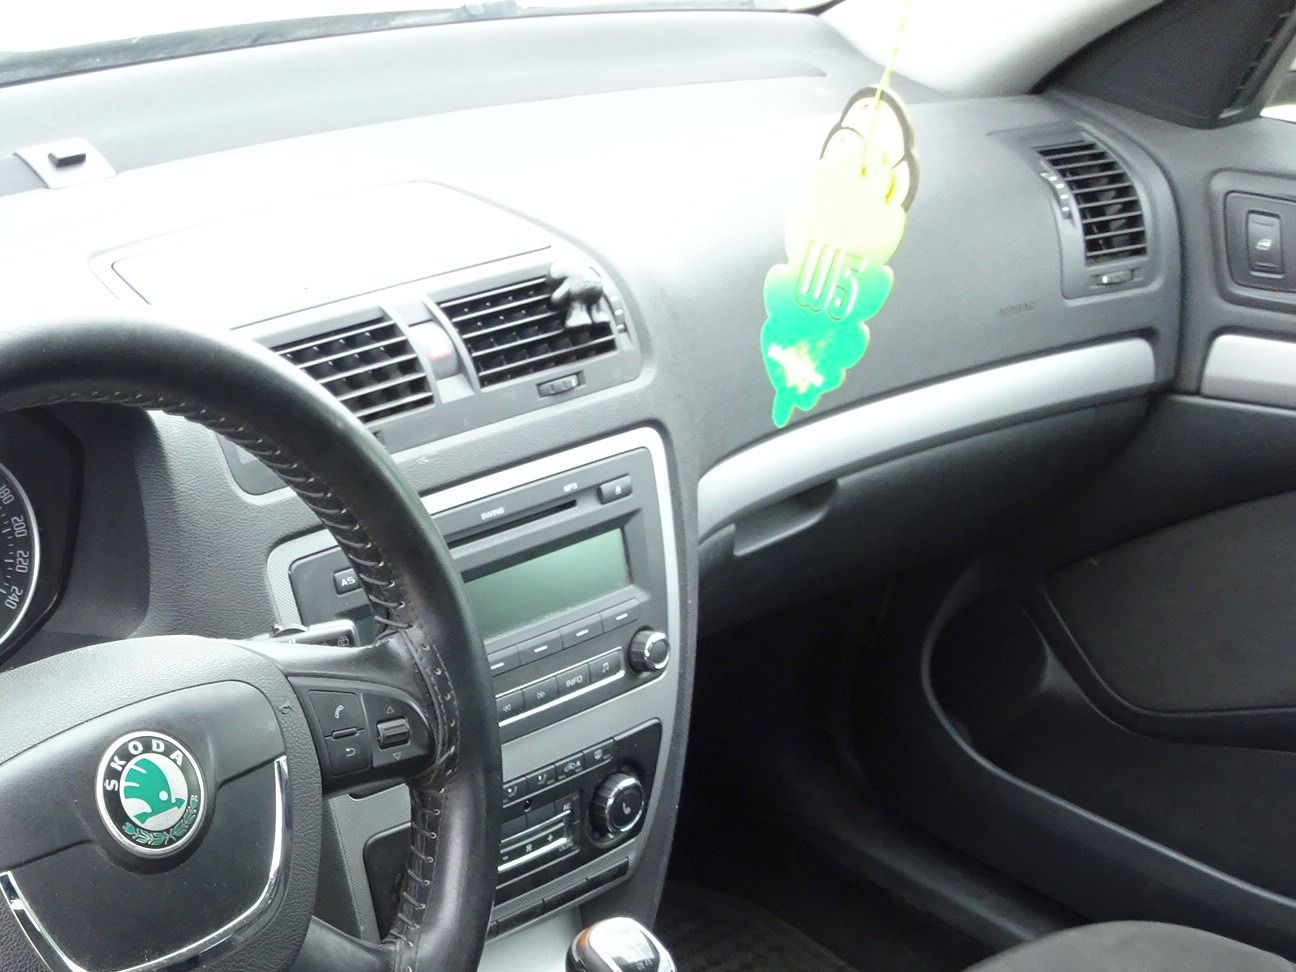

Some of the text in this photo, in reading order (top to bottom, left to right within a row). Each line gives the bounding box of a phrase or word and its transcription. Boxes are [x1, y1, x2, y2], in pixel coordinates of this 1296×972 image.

[11, 515, 28, 538] 200
[15, 550, 30, 573] 220
[340, 575, 356, 588] AS
[4, 584, 24, 610] 240
